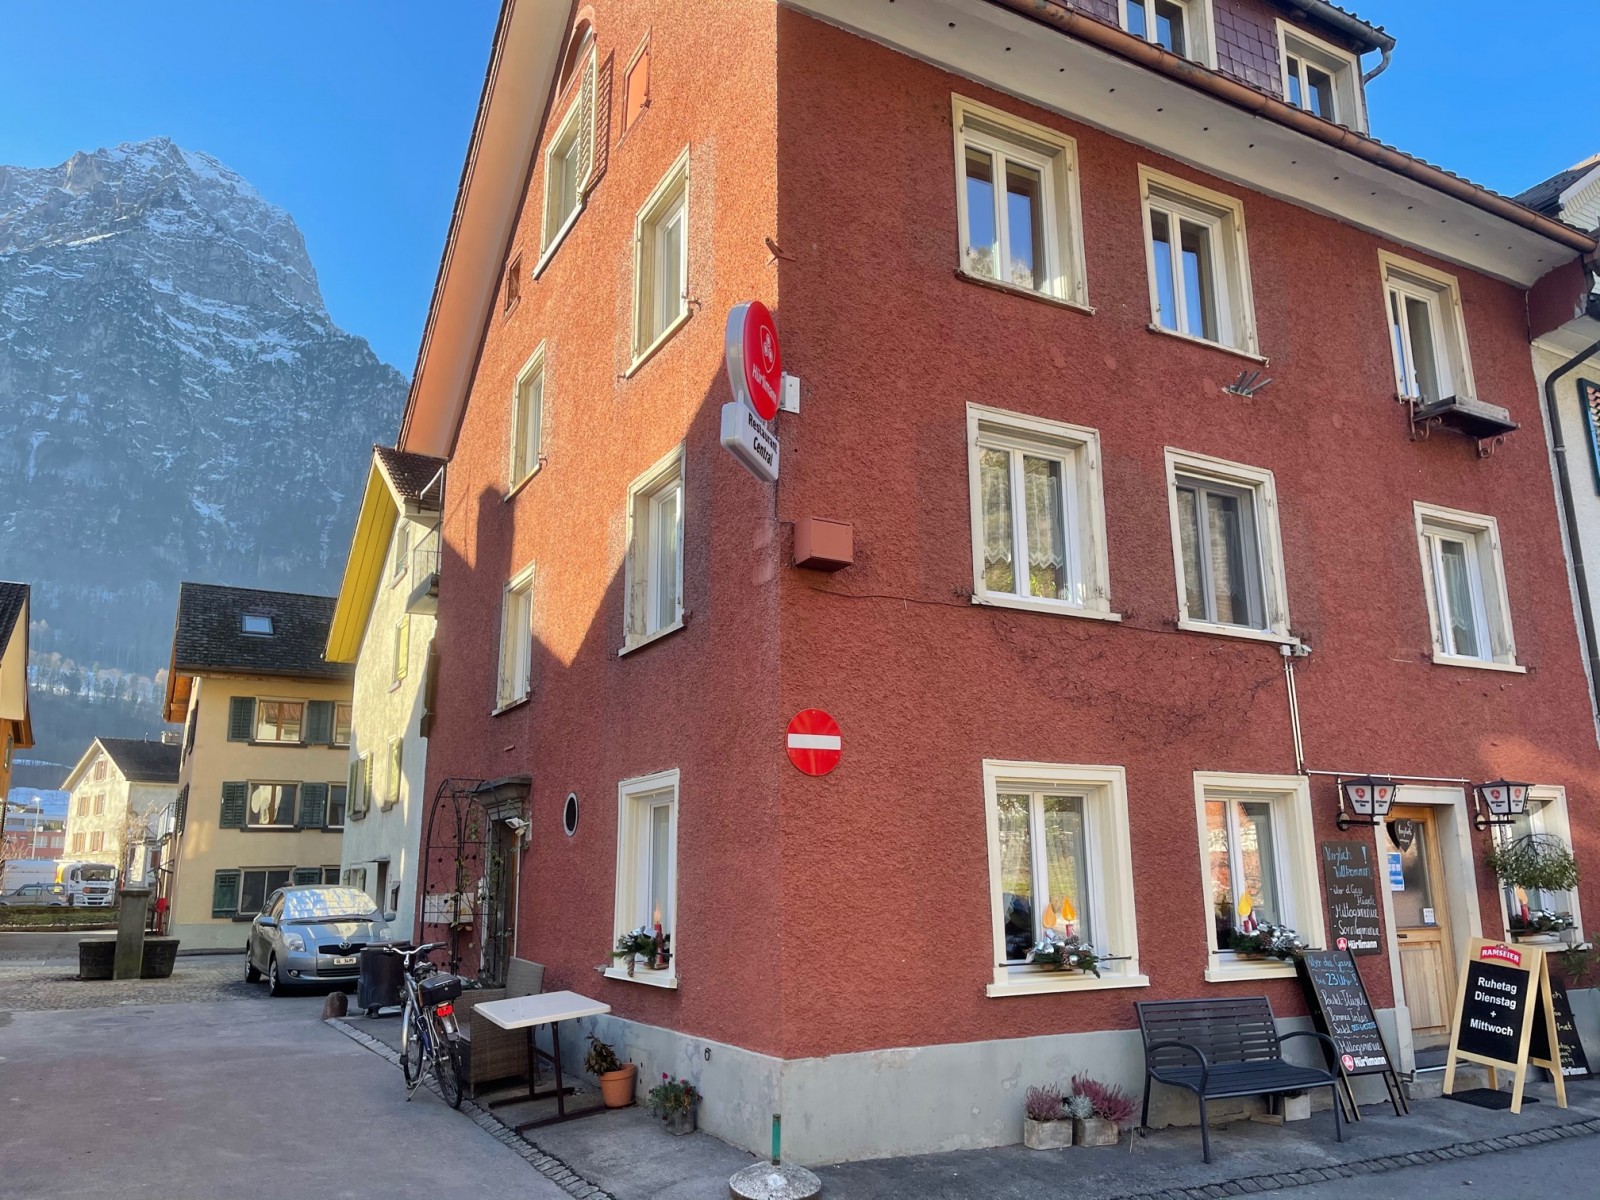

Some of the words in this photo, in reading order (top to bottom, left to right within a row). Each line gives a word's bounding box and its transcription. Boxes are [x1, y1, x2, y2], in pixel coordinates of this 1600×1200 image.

[748, 411, 778, 454] Restaurant
[753, 436, 774, 467] Central
[1347, 939, 1378, 950] Hürlimann
[1481, 948, 1520, 963] RAMSEIER
[1325, 972, 1339, 986] 23
[1477, 976, 1518, 995] Ruhetag
[1474, 990, 1517, 1010] Dienstag
[1469, 1018, 1514, 1037] Mittwoch
[1353, 1056, 1387, 1068] Hürlimann
